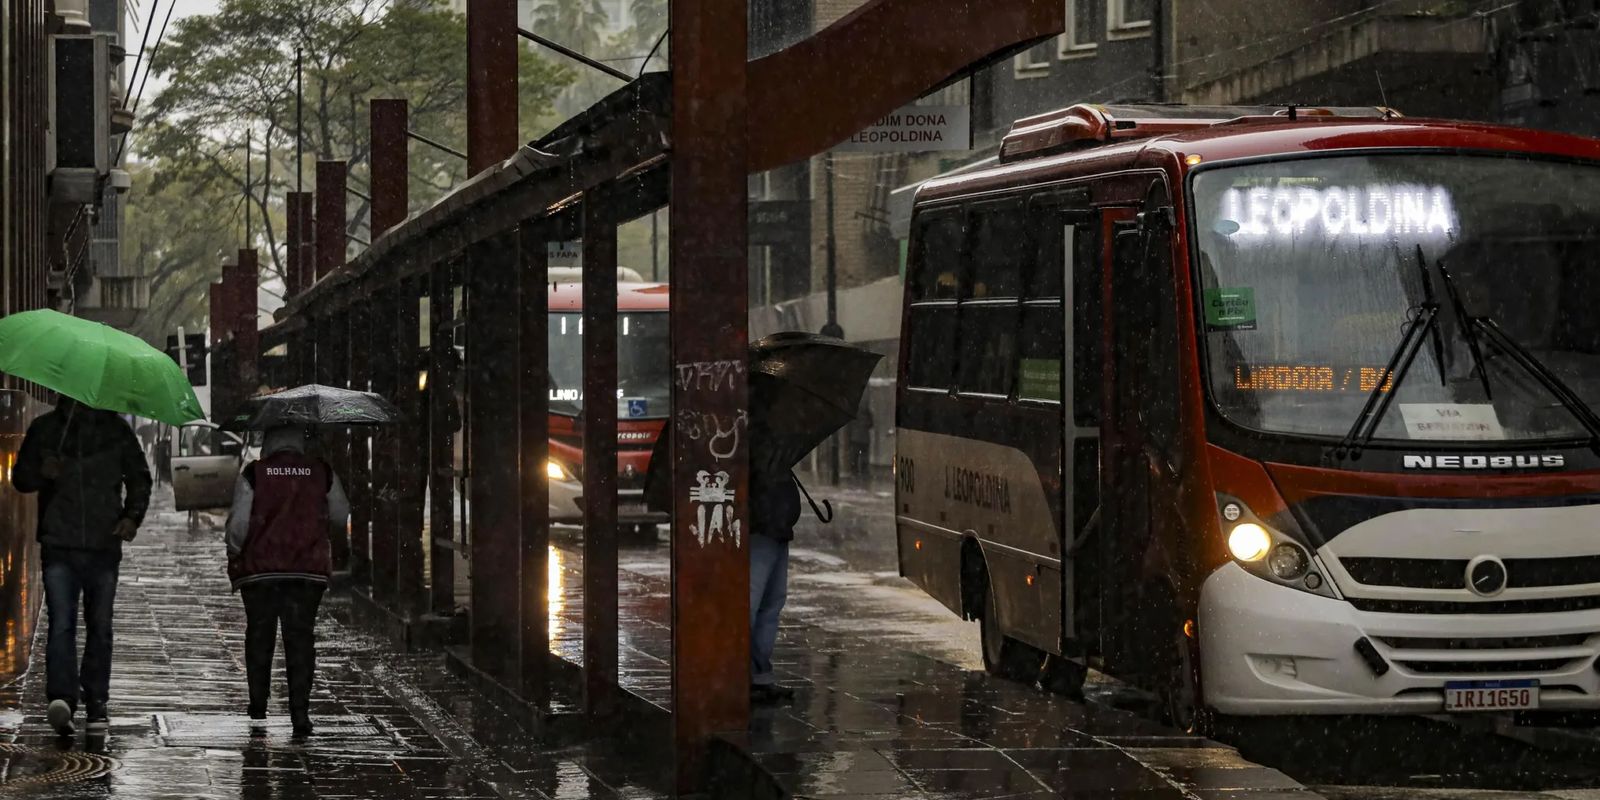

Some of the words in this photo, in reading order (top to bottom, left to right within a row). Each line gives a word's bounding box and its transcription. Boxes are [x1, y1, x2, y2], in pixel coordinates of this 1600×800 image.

[872, 114, 901, 127] DIM
[906, 114, 946, 126] DONA
[851, 130, 943, 143] LEOPOLDINA
[1227, 189, 1453, 235] LEOPOLDINA
[557, 251, 578, 259] FAPA
[549, 389, 578, 401] LINIO
[617, 432, 651, 441] rcopolo
[1403, 454, 1565, 469] NEOBUS
[266, 467, 312, 477] ROLHANO
[953, 466, 1011, 514] LEOPOLDINA
[1454, 689, 1530, 708] IRI1G50
